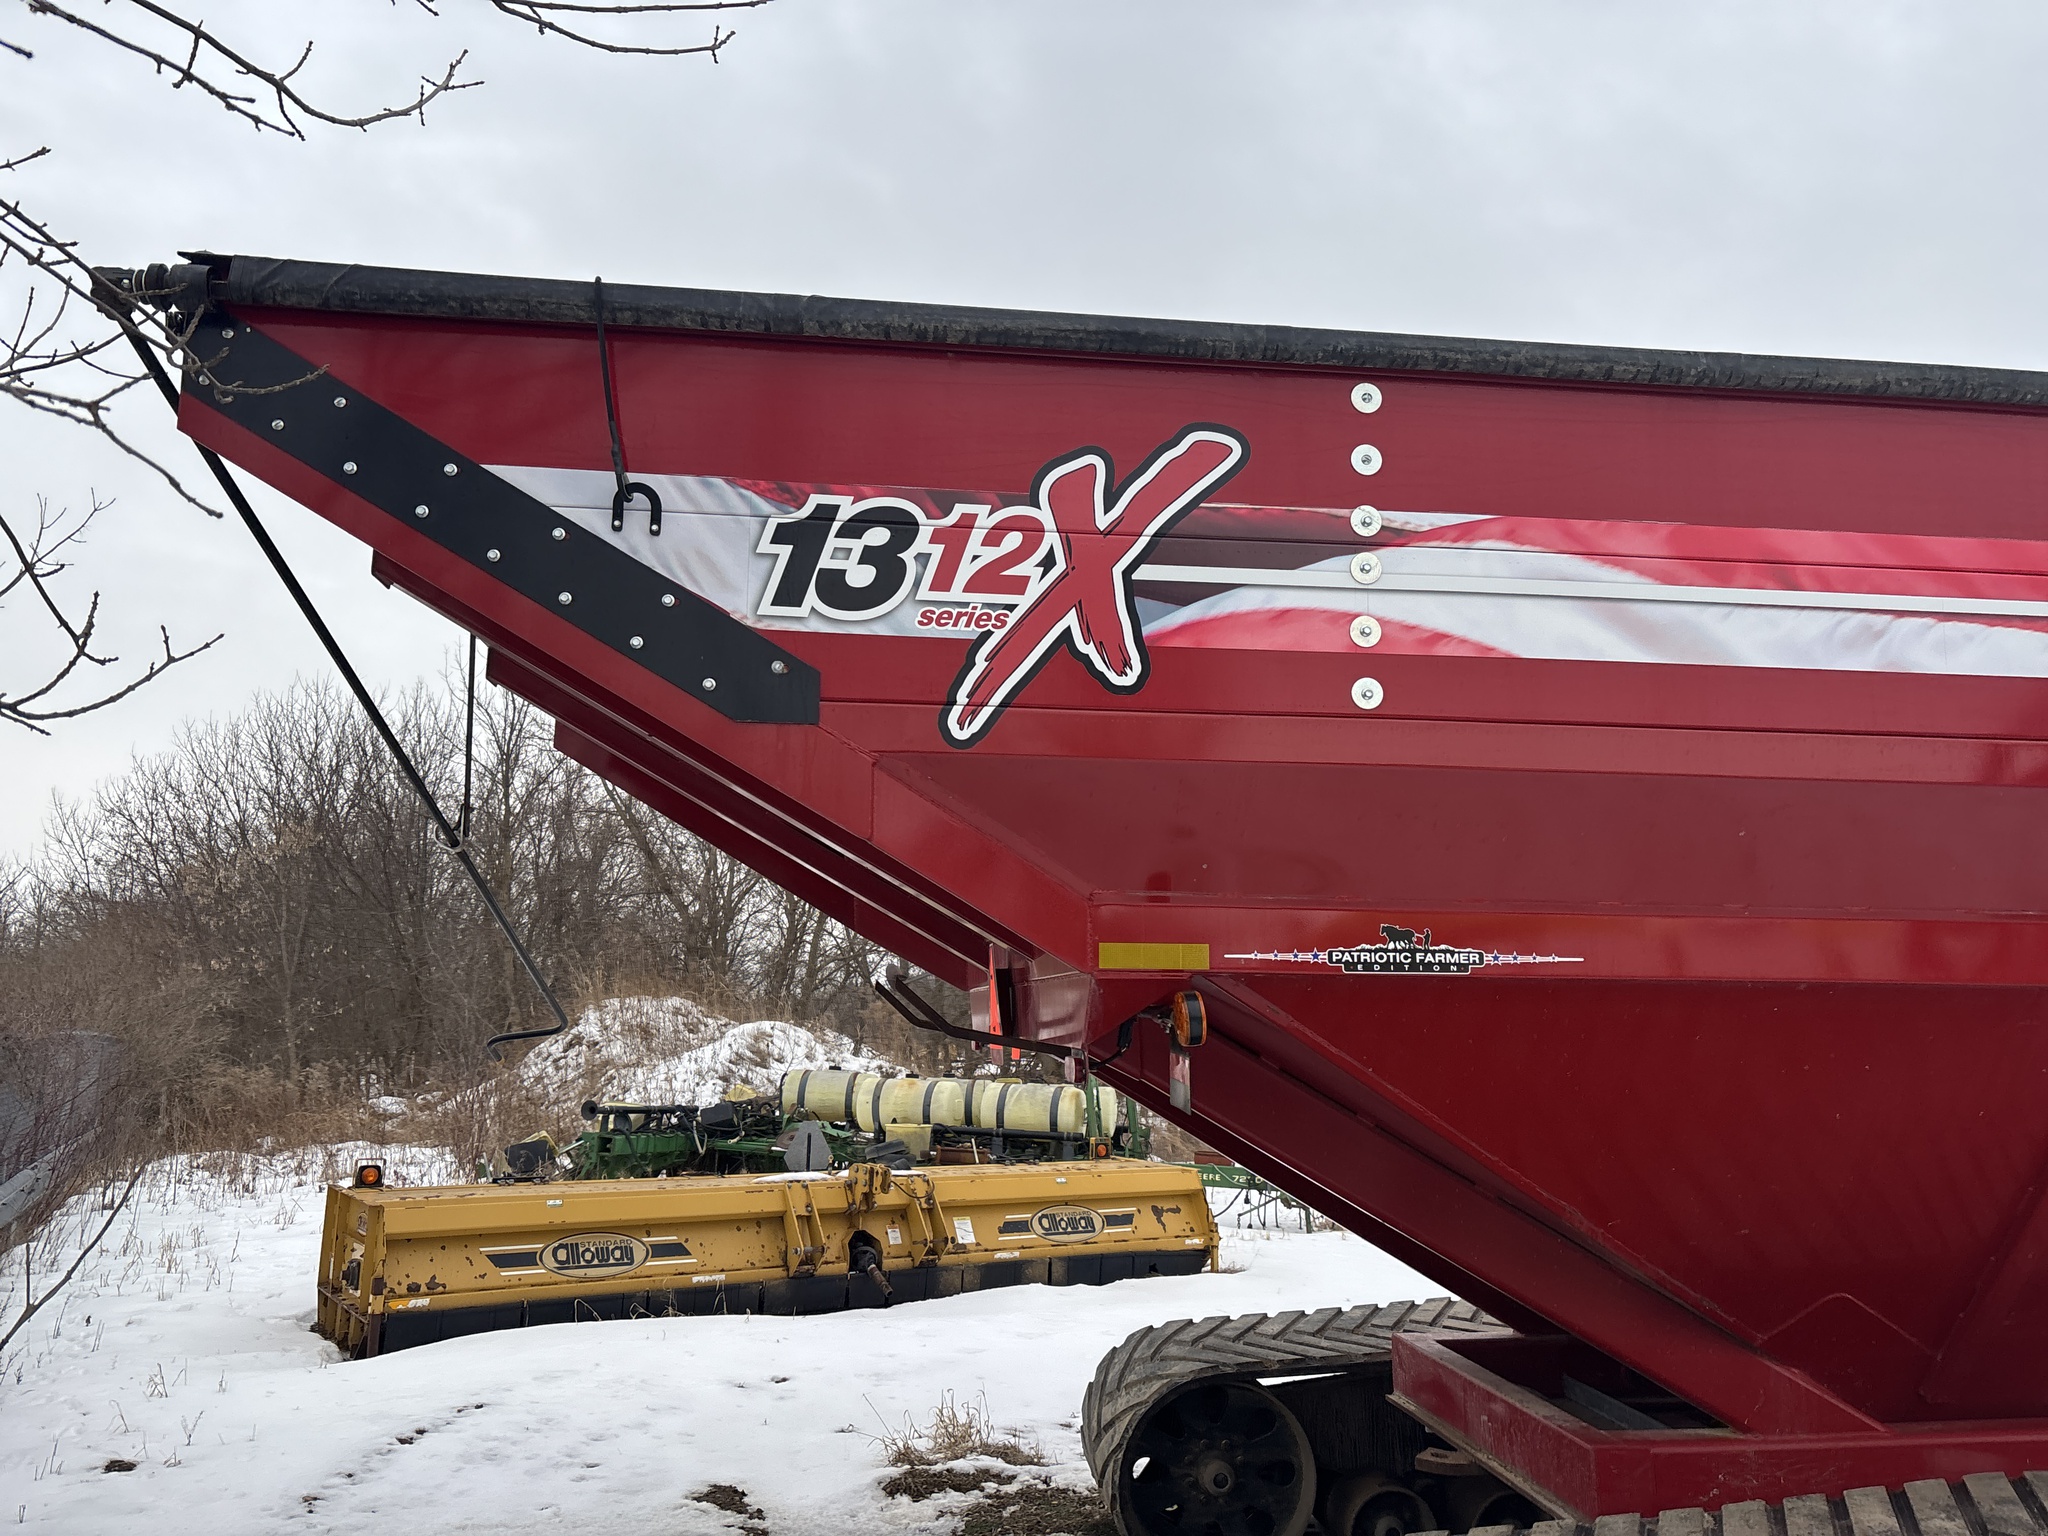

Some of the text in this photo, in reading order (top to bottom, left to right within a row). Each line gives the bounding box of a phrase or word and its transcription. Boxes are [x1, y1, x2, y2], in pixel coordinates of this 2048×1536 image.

[917, 605, 1010, 630] series
[1332, 951, 1480, 964] PATRIOTIC FARMER
[1357, 963, 1458, 972] EDITION
[1197, 1172, 1221, 1182] EERE
[1055, 1210, 1092, 1218] STANDARD
[580, 1239, 633, 1248] STANDARD
